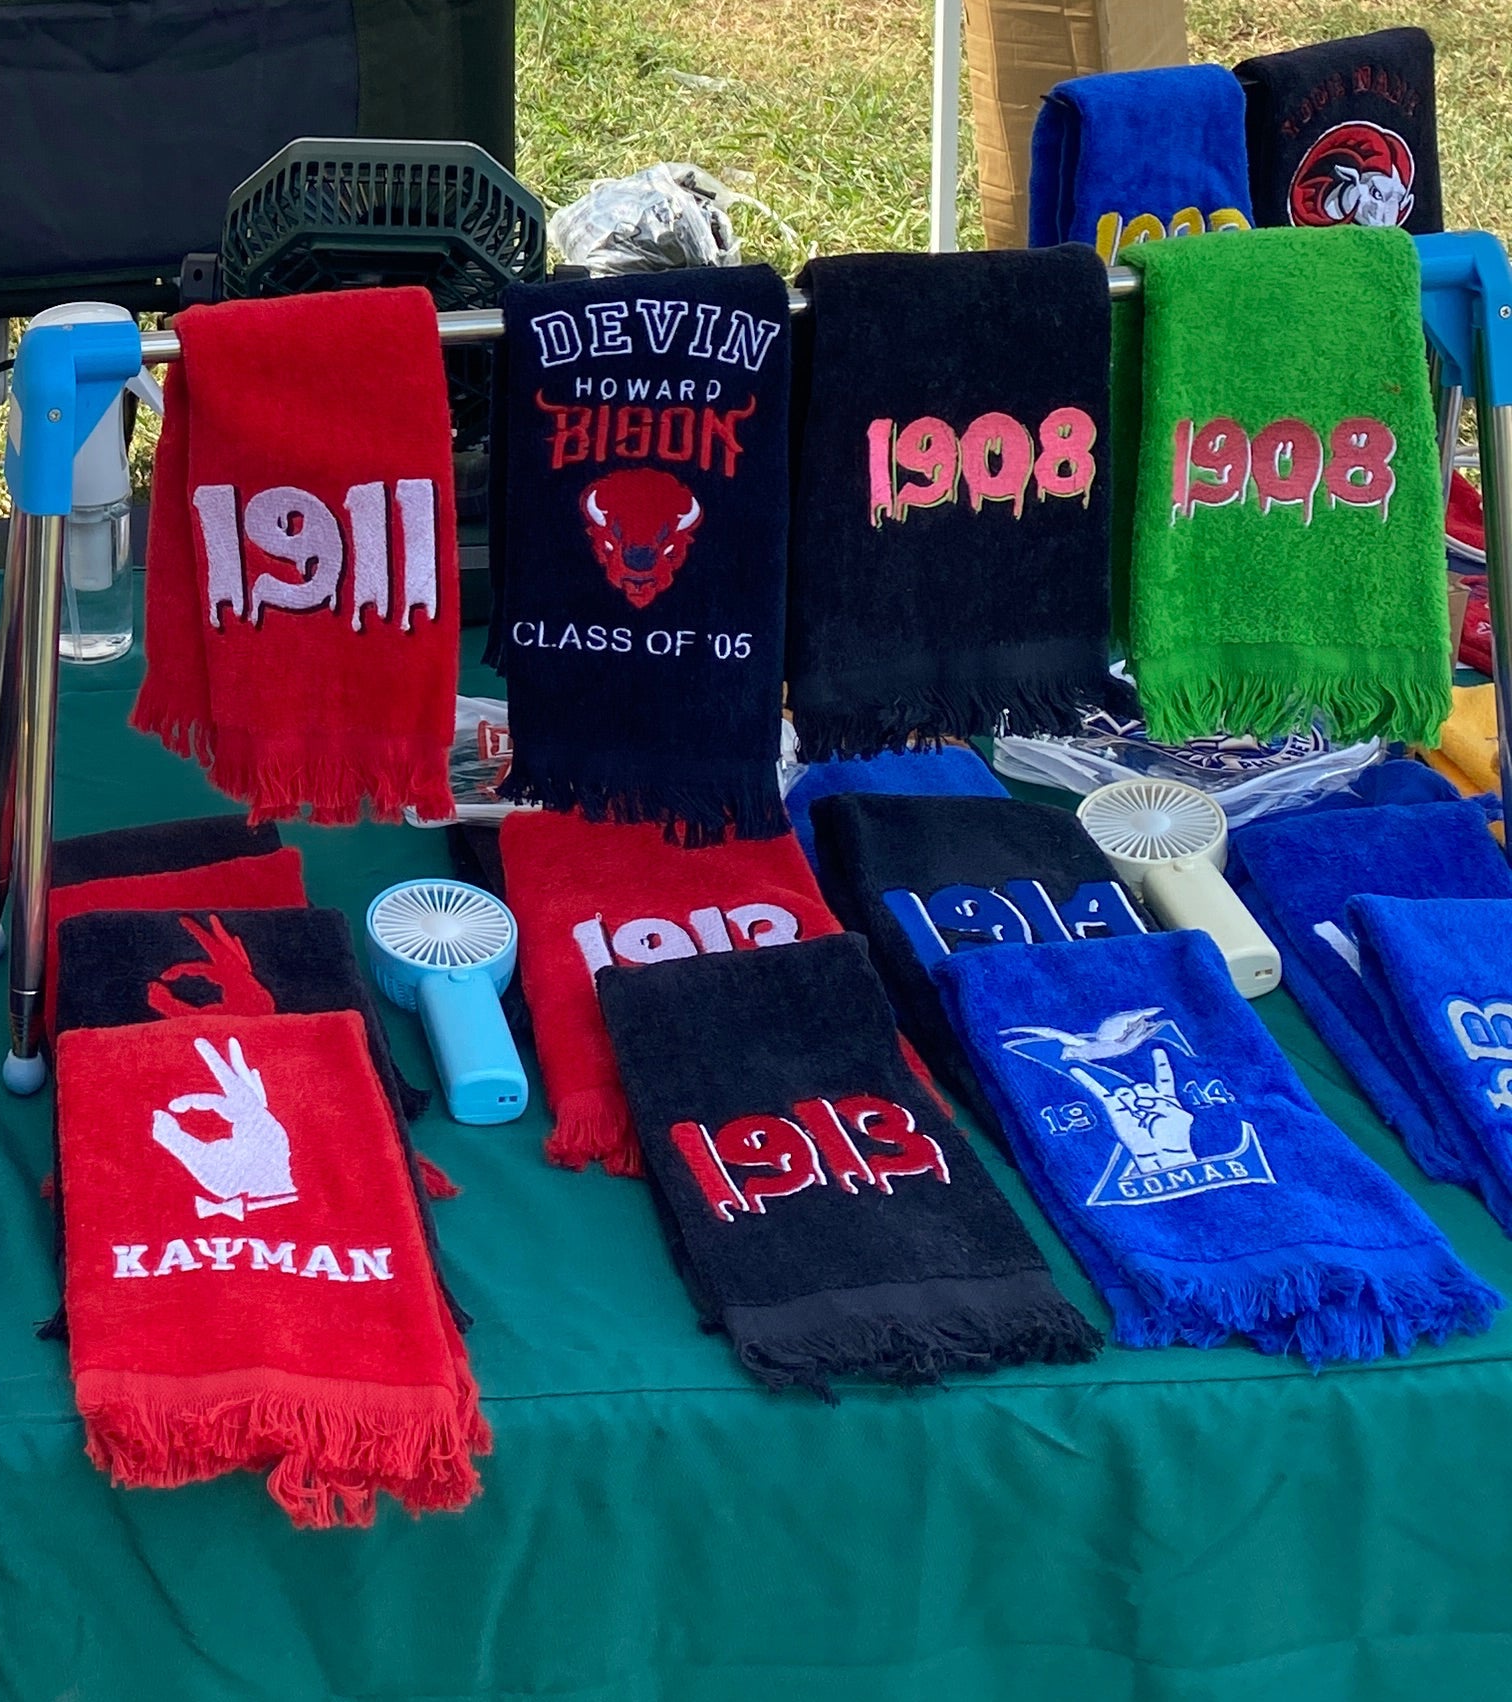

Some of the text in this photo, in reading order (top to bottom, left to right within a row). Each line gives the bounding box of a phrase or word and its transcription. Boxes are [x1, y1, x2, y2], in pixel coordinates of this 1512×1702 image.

[530, 298, 781, 372] DEVIN
[536, 388, 756, 478] BISON
[575, 376, 722, 401] HOWARD
[866, 407, 1097, 529] 1908
[1171, 416, 1397, 528] 1908
[192, 478, 438, 634] 1911
[512, 620, 753, 660] CLASS OF '05
[1183, 1078, 1236, 1110] 14
[670, 1095, 952, 1223] 1913
